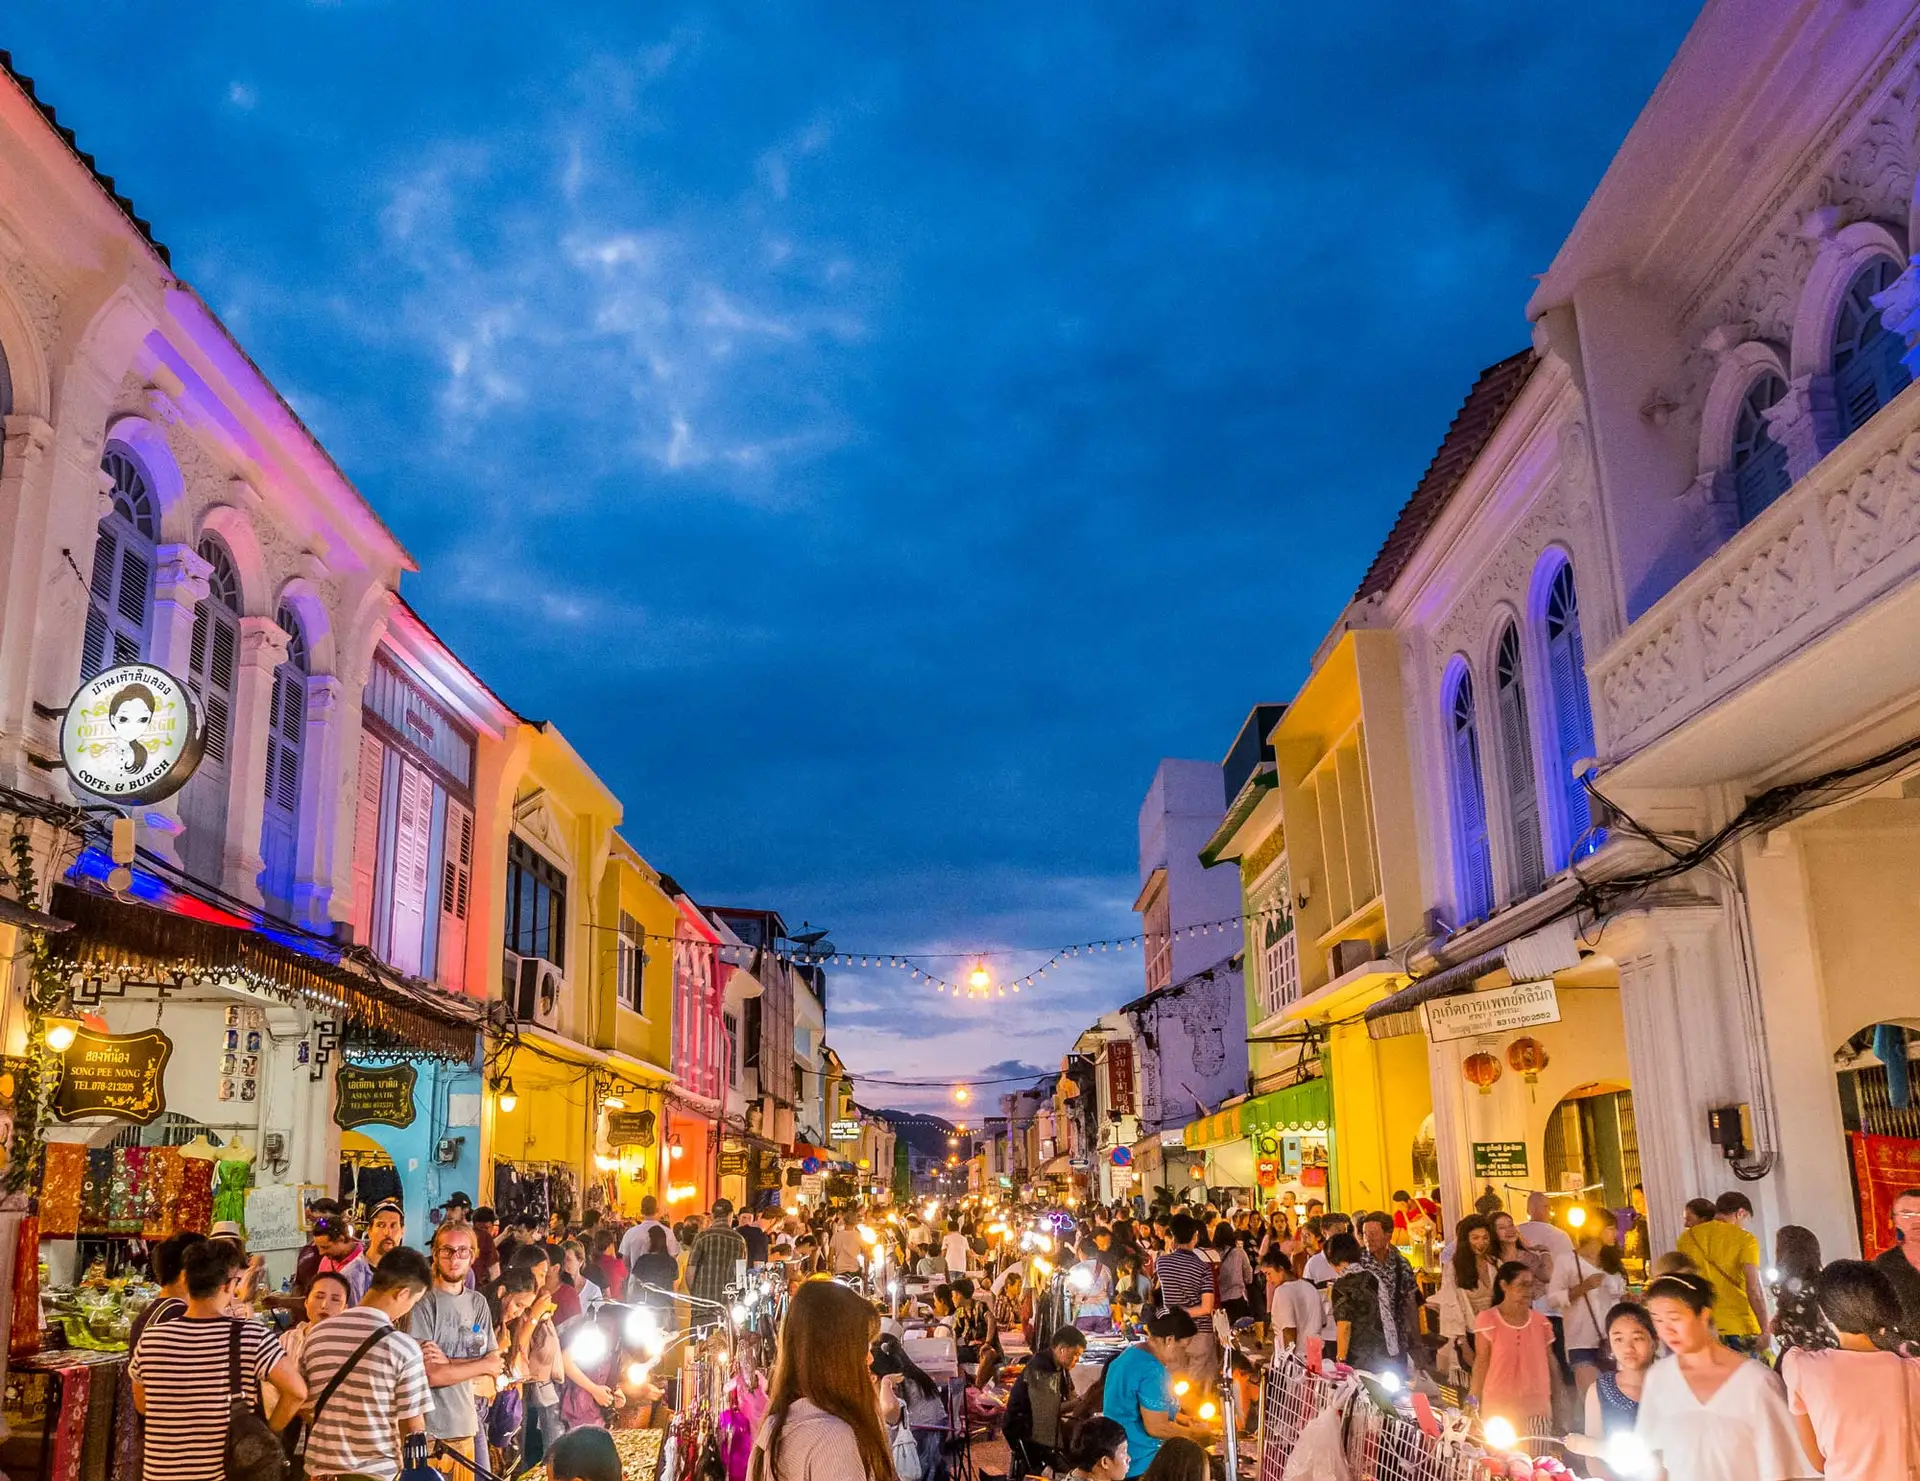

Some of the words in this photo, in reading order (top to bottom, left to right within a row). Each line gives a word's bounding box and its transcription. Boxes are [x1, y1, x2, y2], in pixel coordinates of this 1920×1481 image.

[114, 780, 125, 792] &
[129, 759, 171, 791] BURGH
[85, 1044, 130, 1063] สองพี่น้อง
[70, 1066, 95, 1076] SONG
[97, 1067, 113, 1077] PEE
[115, 1068, 141, 1078] NONG
